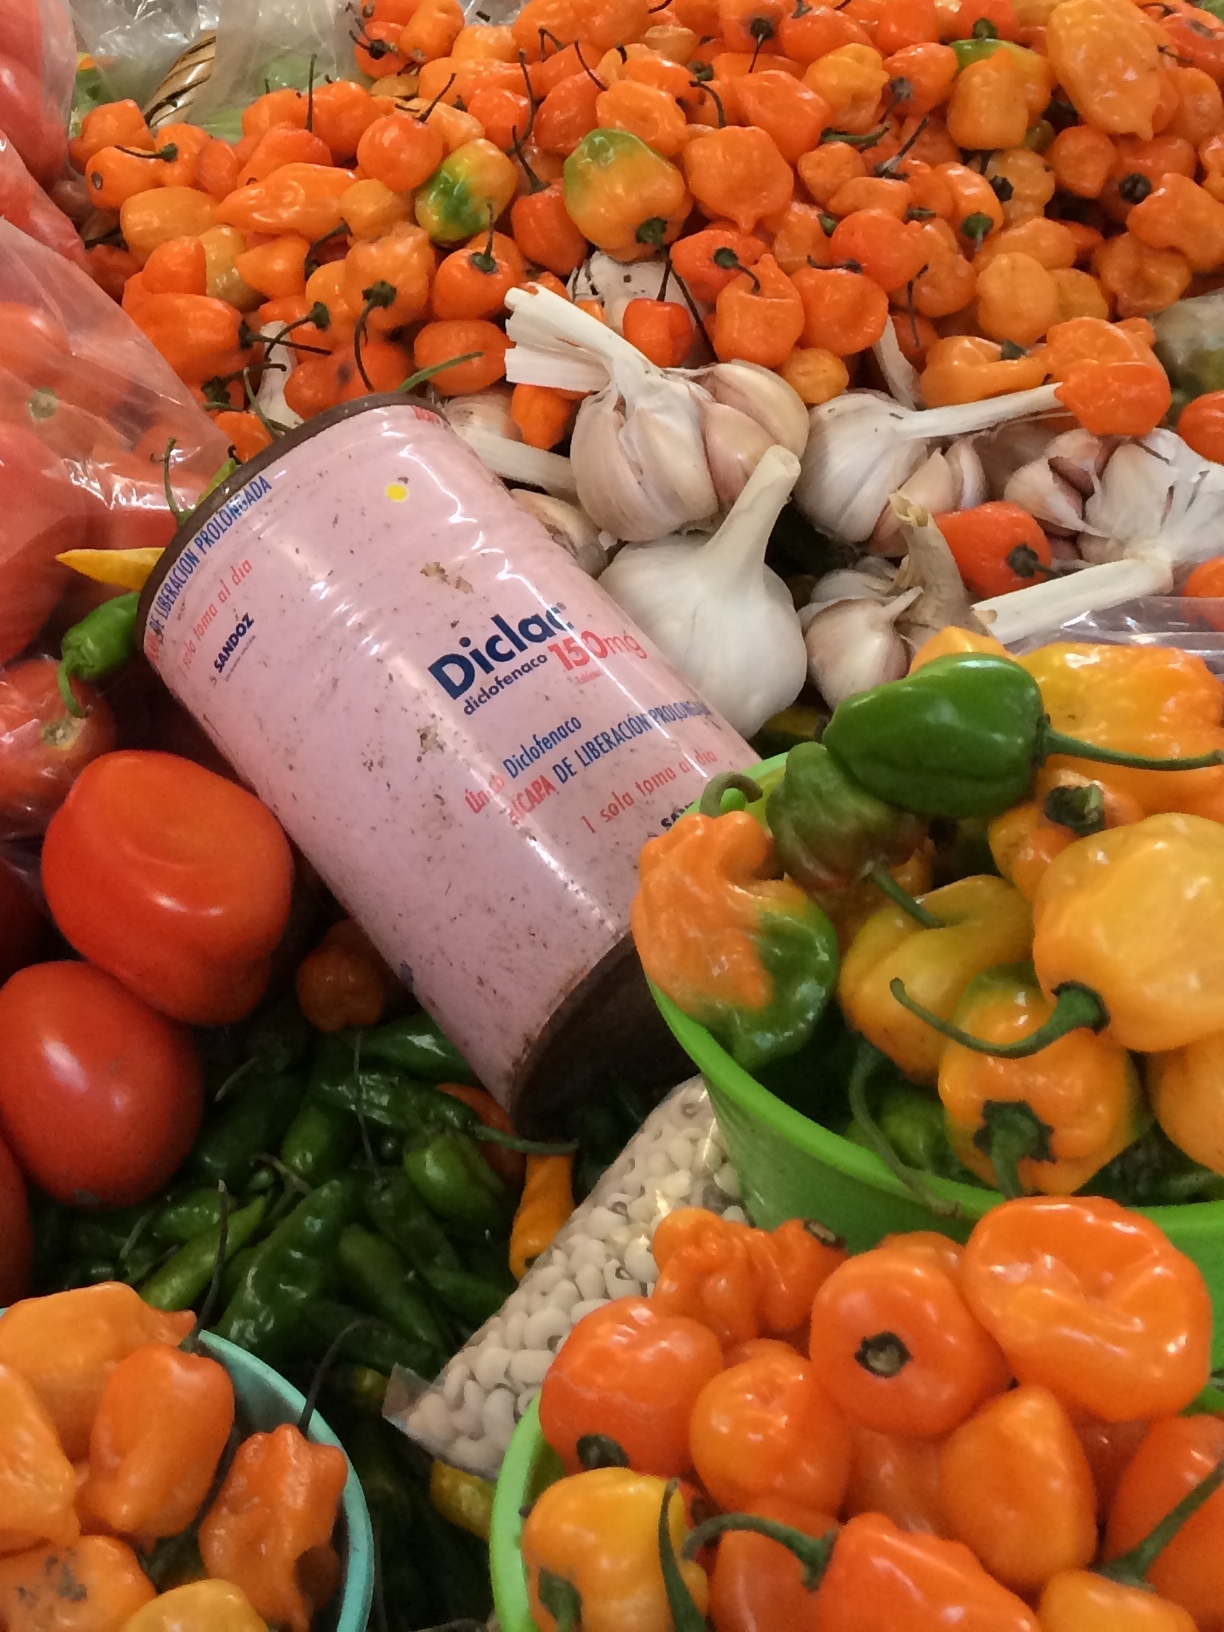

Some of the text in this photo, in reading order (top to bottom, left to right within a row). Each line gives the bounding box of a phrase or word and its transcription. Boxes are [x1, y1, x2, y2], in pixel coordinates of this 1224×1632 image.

[193, 475, 272, 555] PROLONGADA
[193, 603, 218, 642] toma
[218, 578, 231, 604] al
[213, 612, 255, 674] SANDOZ
[462, 652, 549, 716] diclofenaco
[502, 715, 583, 780] Diclofenaco
[552, 756, 579, 784] DE
[575, 713, 653, 768] LIBERACIÓN
[580, 815, 597, 834] 1
[599, 789, 635, 823] sola
[634, 766, 677, 797] toma
